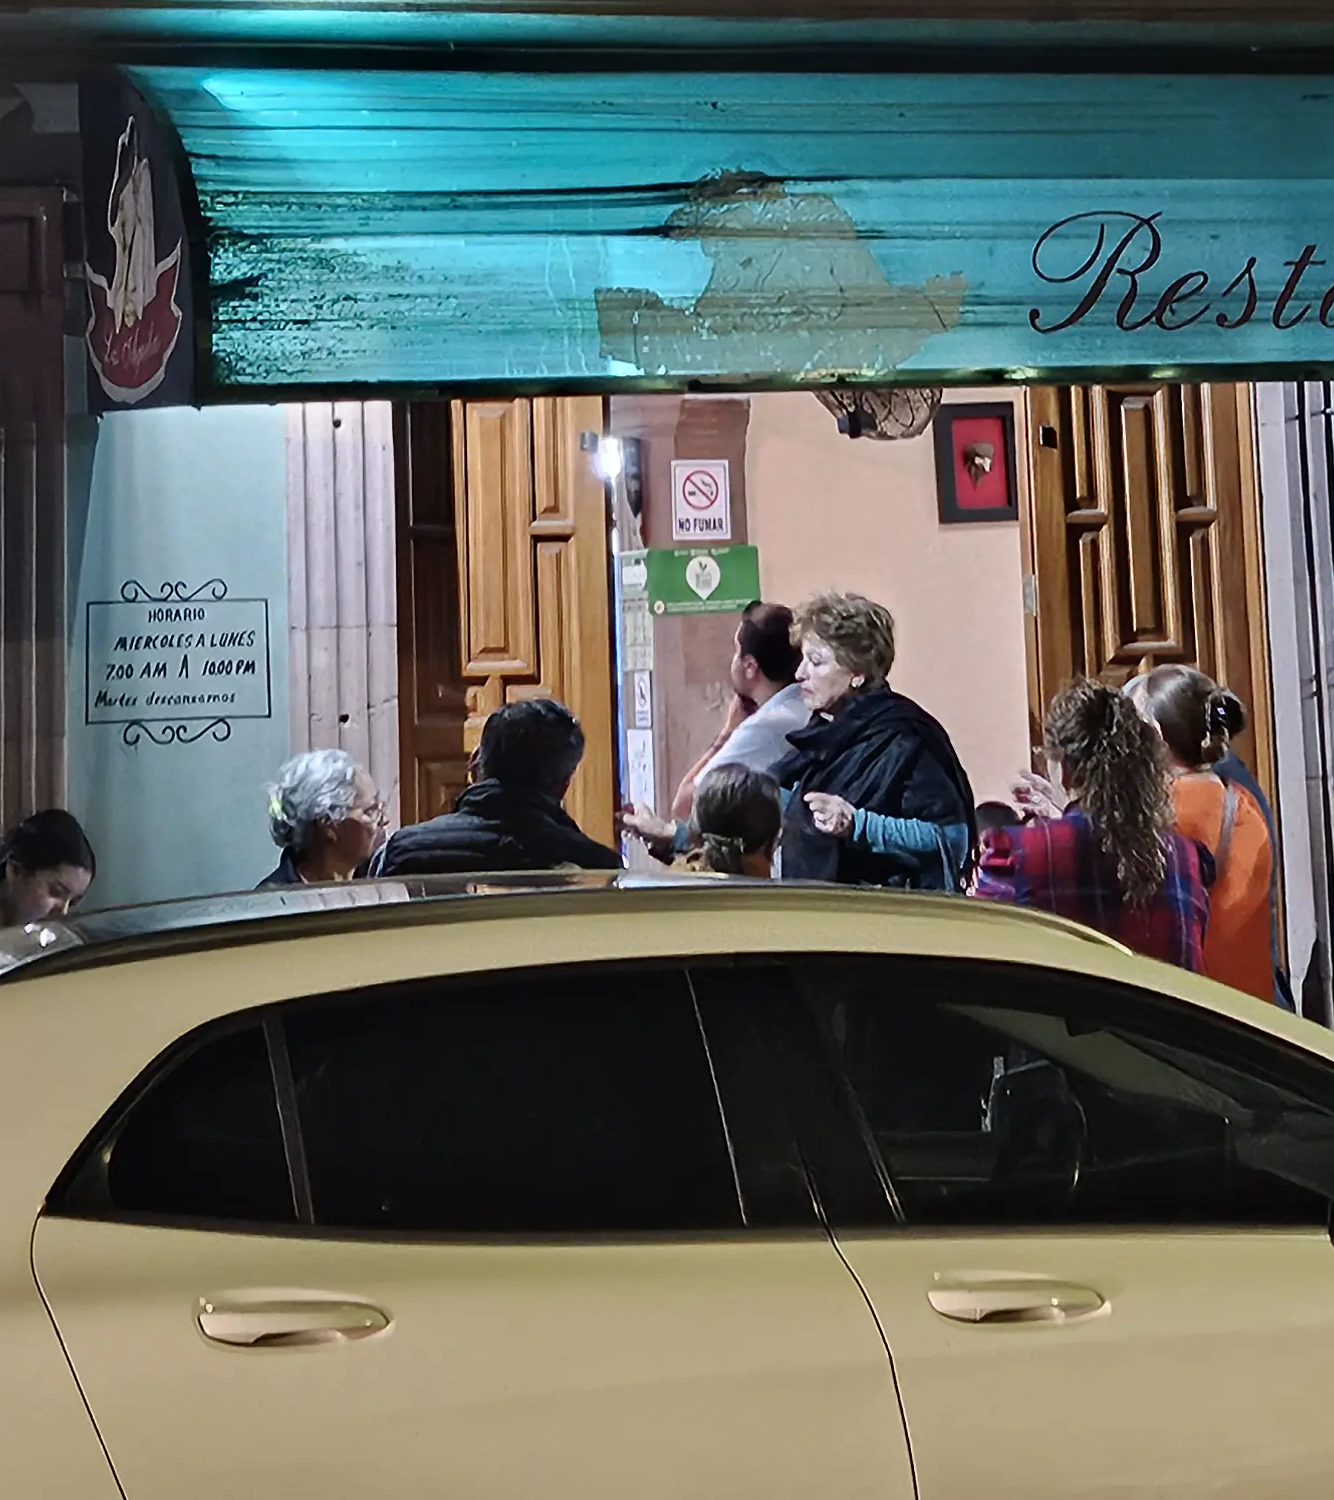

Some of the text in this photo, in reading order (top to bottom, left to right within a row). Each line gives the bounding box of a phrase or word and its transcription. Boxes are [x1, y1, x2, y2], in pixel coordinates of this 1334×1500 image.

[678, 517, 724, 532] NO FUMAR
[148, 607, 205, 623] HORARIO
[113, 630, 256, 651] MIERCOLES A LUNES
[139, 661, 167, 679] AM
[235, 659, 256, 675] PM
